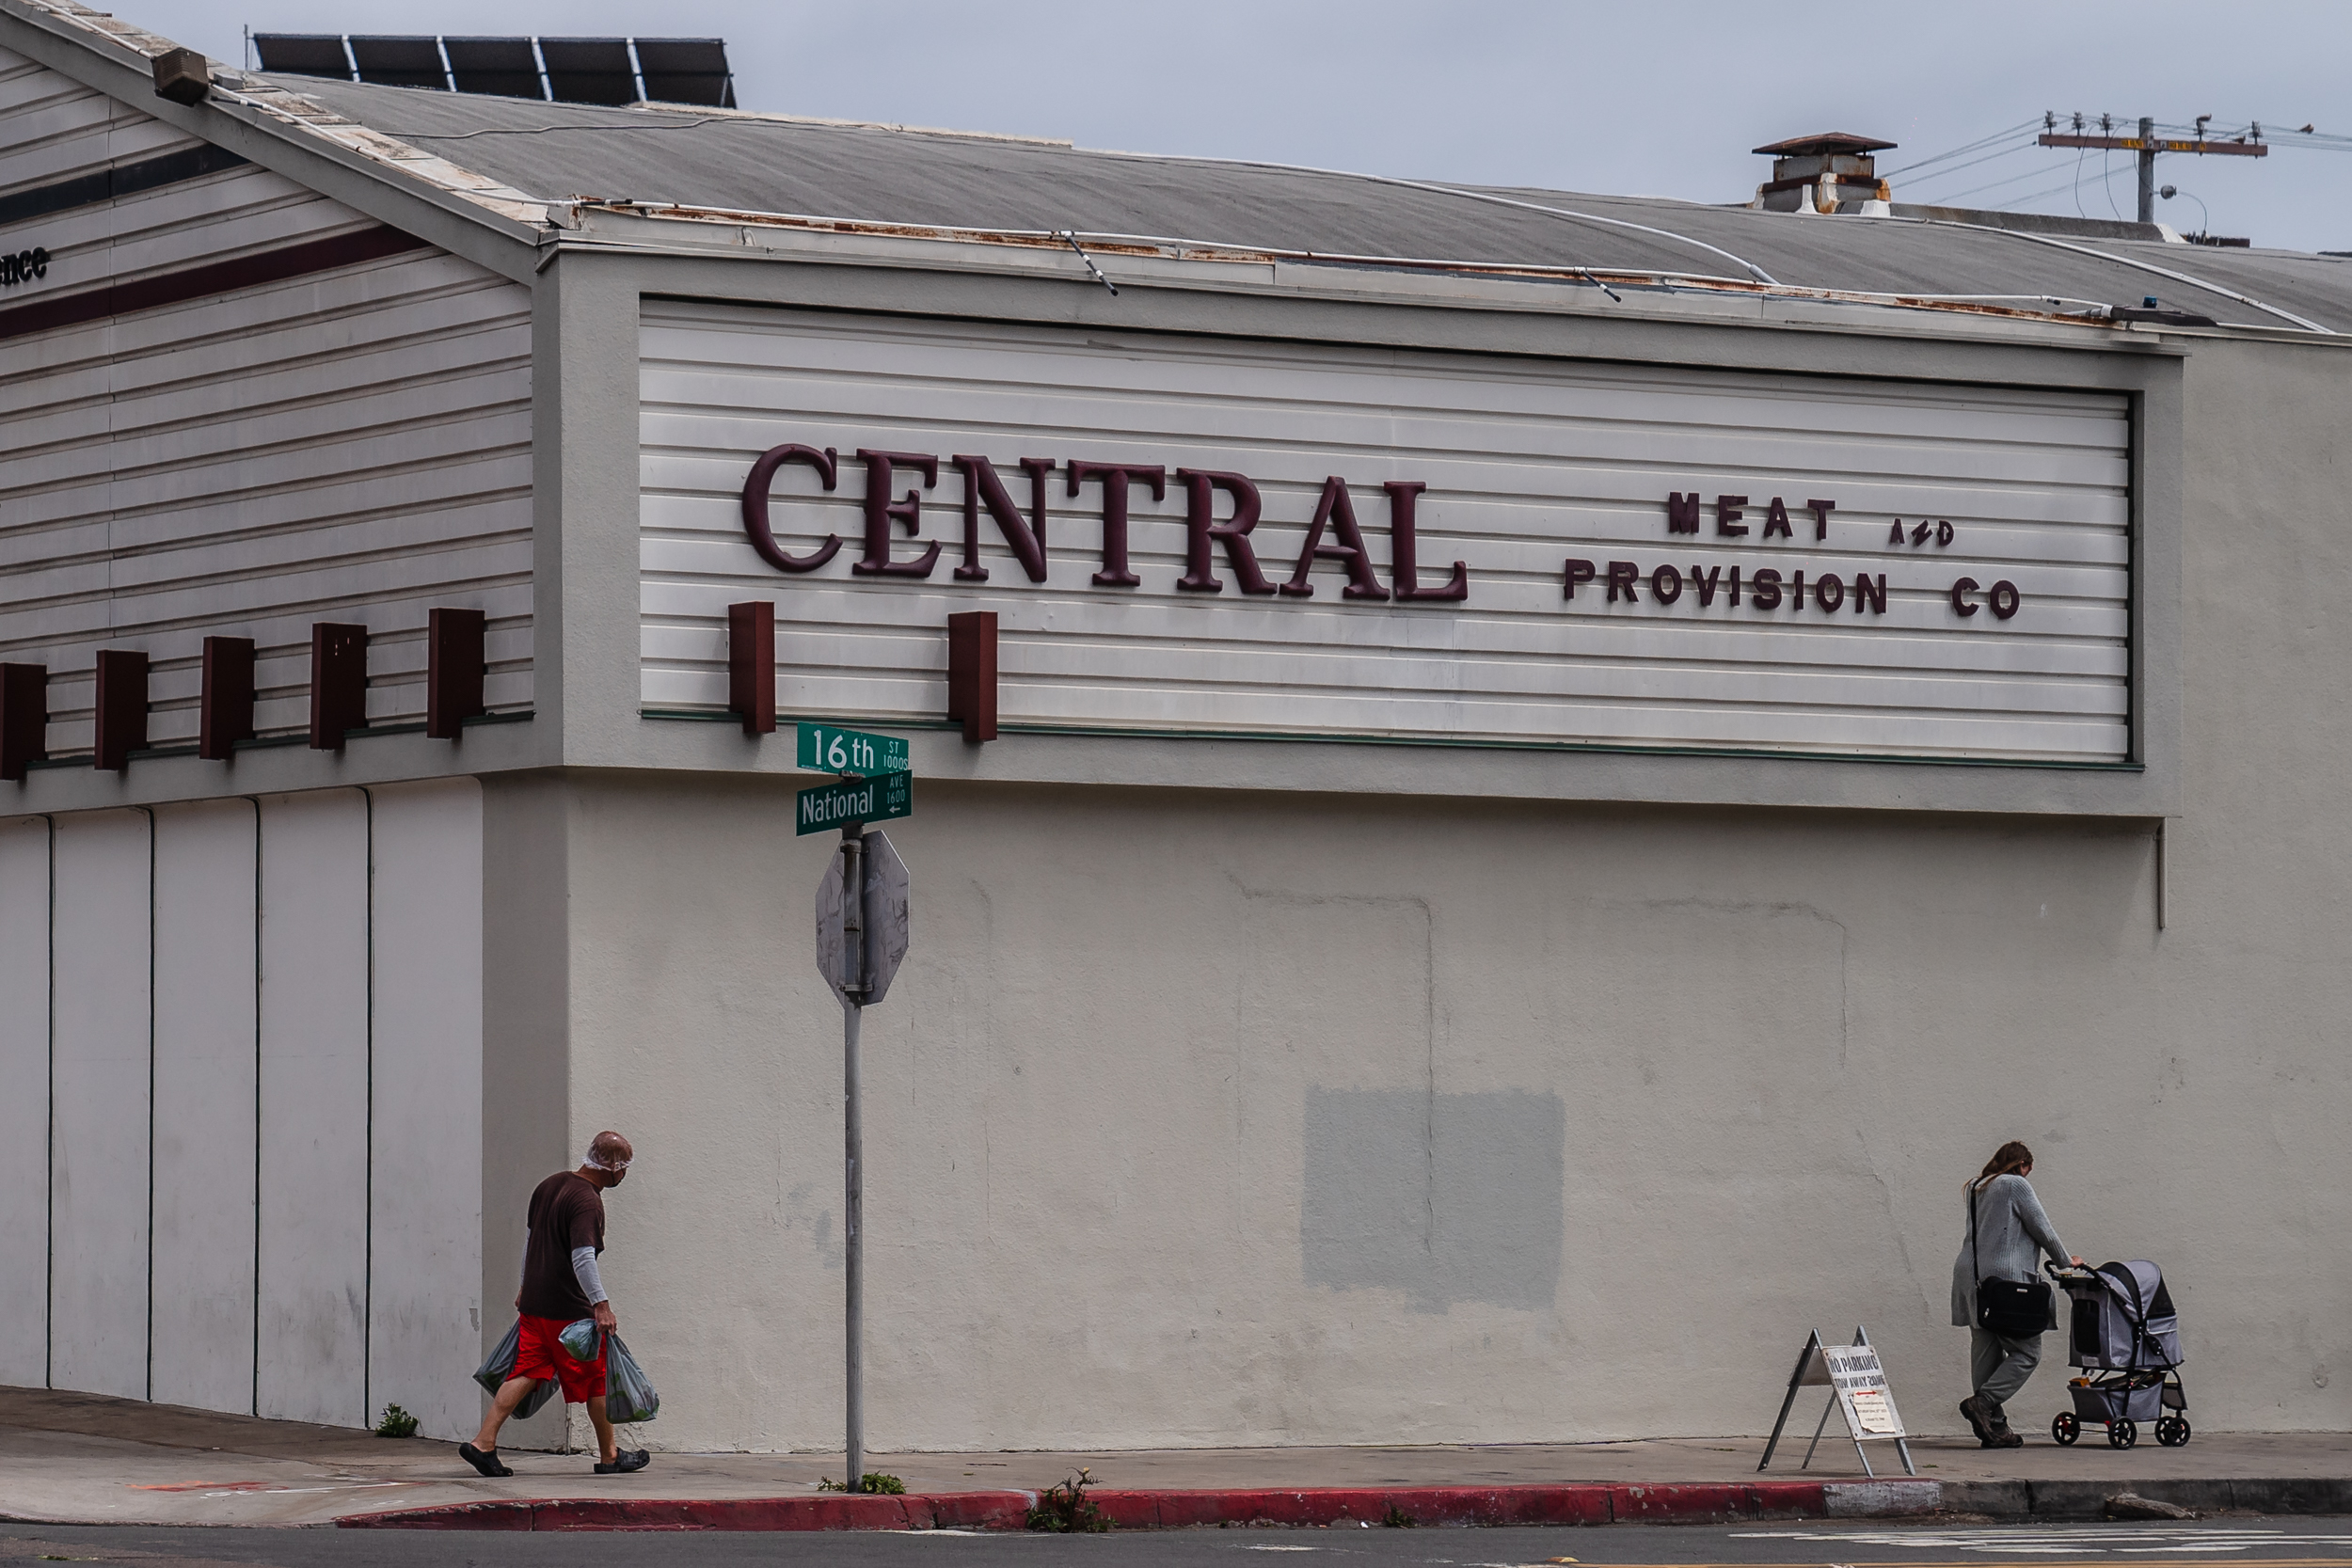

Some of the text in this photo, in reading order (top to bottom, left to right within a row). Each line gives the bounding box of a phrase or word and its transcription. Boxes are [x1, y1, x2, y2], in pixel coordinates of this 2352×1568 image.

[0, 246, 50, 286] nce
[740, 443, 1469, 600] CENTRAL
[1668, 492, 1955, 546] MEAT AND
[1564, 558, 2021, 619] PROVISION CO
[813, 729, 899, 769] 16th ST
[803, 774, 904, 825] National AVE
[886, 789, 905, 804] 1600
[1828, 1354, 1879, 1373] NO PARKING
[1835, 1377, 1849, 1389] TOW
[1849, 1375, 1867, 1388] AWAY
